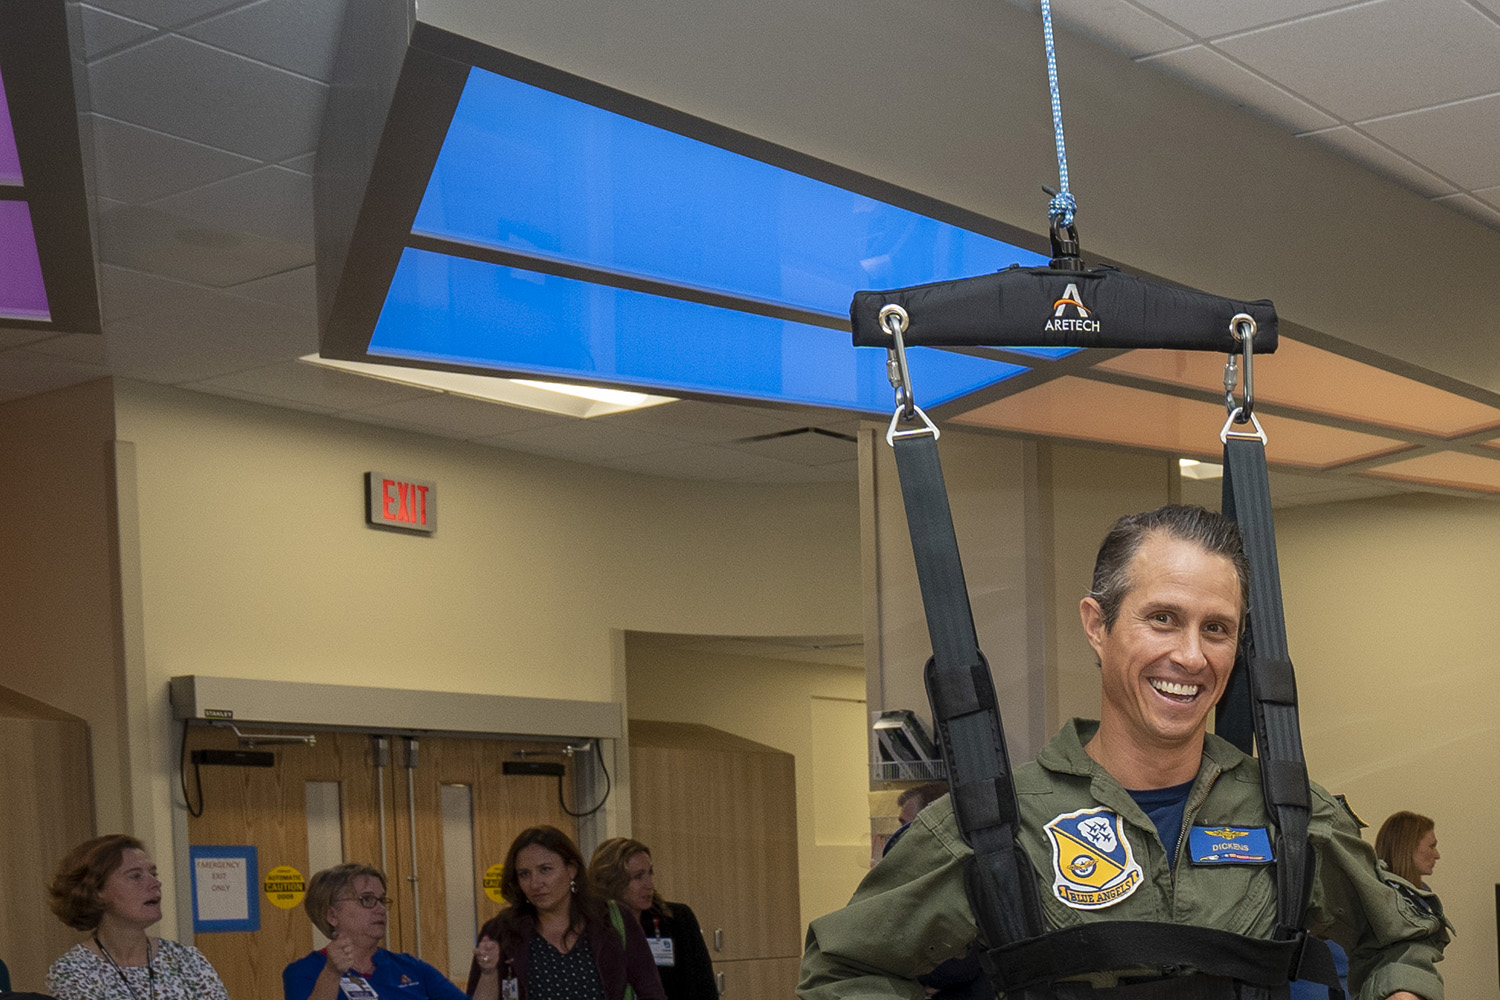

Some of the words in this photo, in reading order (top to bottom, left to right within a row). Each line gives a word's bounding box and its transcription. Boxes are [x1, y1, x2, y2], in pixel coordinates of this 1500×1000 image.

[1044, 319, 1101, 333] ARETECH
[382, 478, 430, 526] EXIT
[1212, 842, 1250, 852] DICKENS
[197, 861, 240, 869] EMERGENCY
[211, 872, 227, 880] EXIT
[211, 884, 231, 892] ONLY
[265, 882, 303, 892] CAUTION
[1069, 891, 1095, 903] BLUE
[1096, 880, 1132, 903] ANGELS
